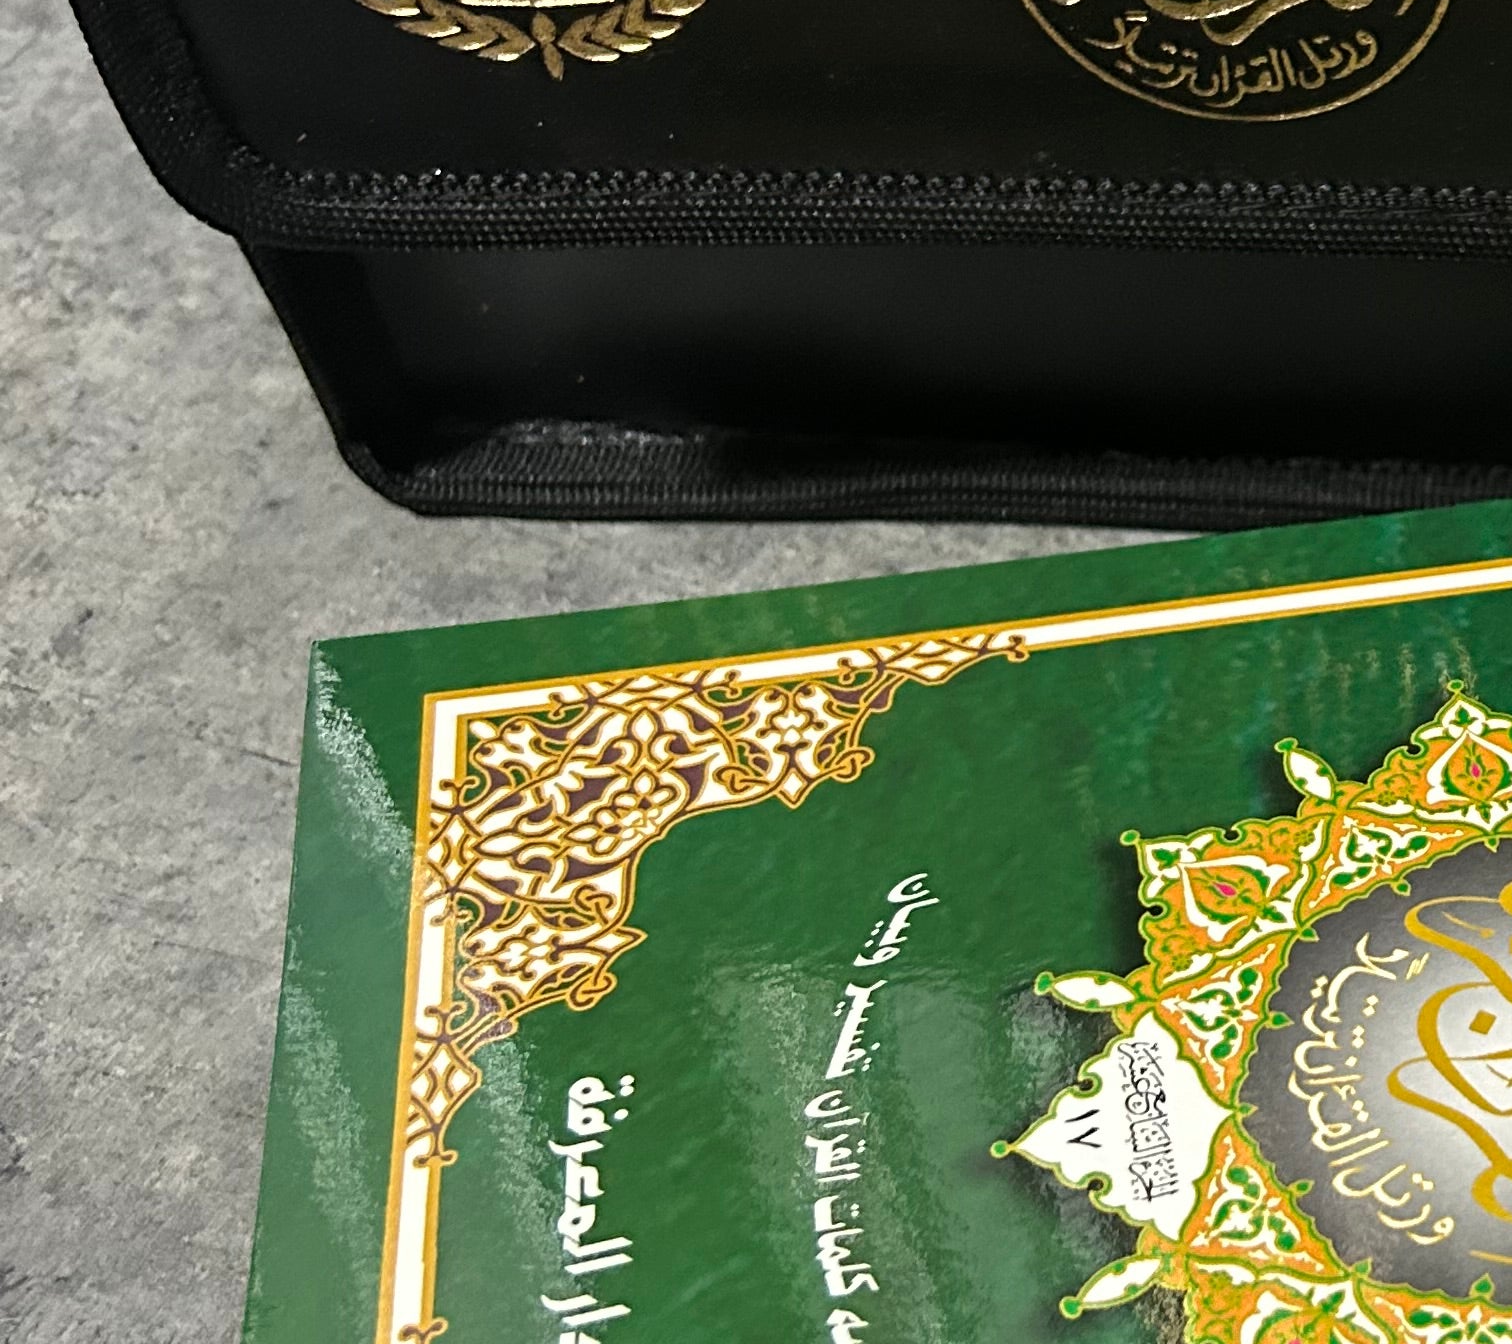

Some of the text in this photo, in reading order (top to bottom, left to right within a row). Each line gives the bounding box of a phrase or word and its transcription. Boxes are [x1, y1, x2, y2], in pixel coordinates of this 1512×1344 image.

[824, 977, 888, 1082] تفسير
[548, 1073, 635, 1276] المعرفة
[812, 1194, 880, 1299] كلمات
